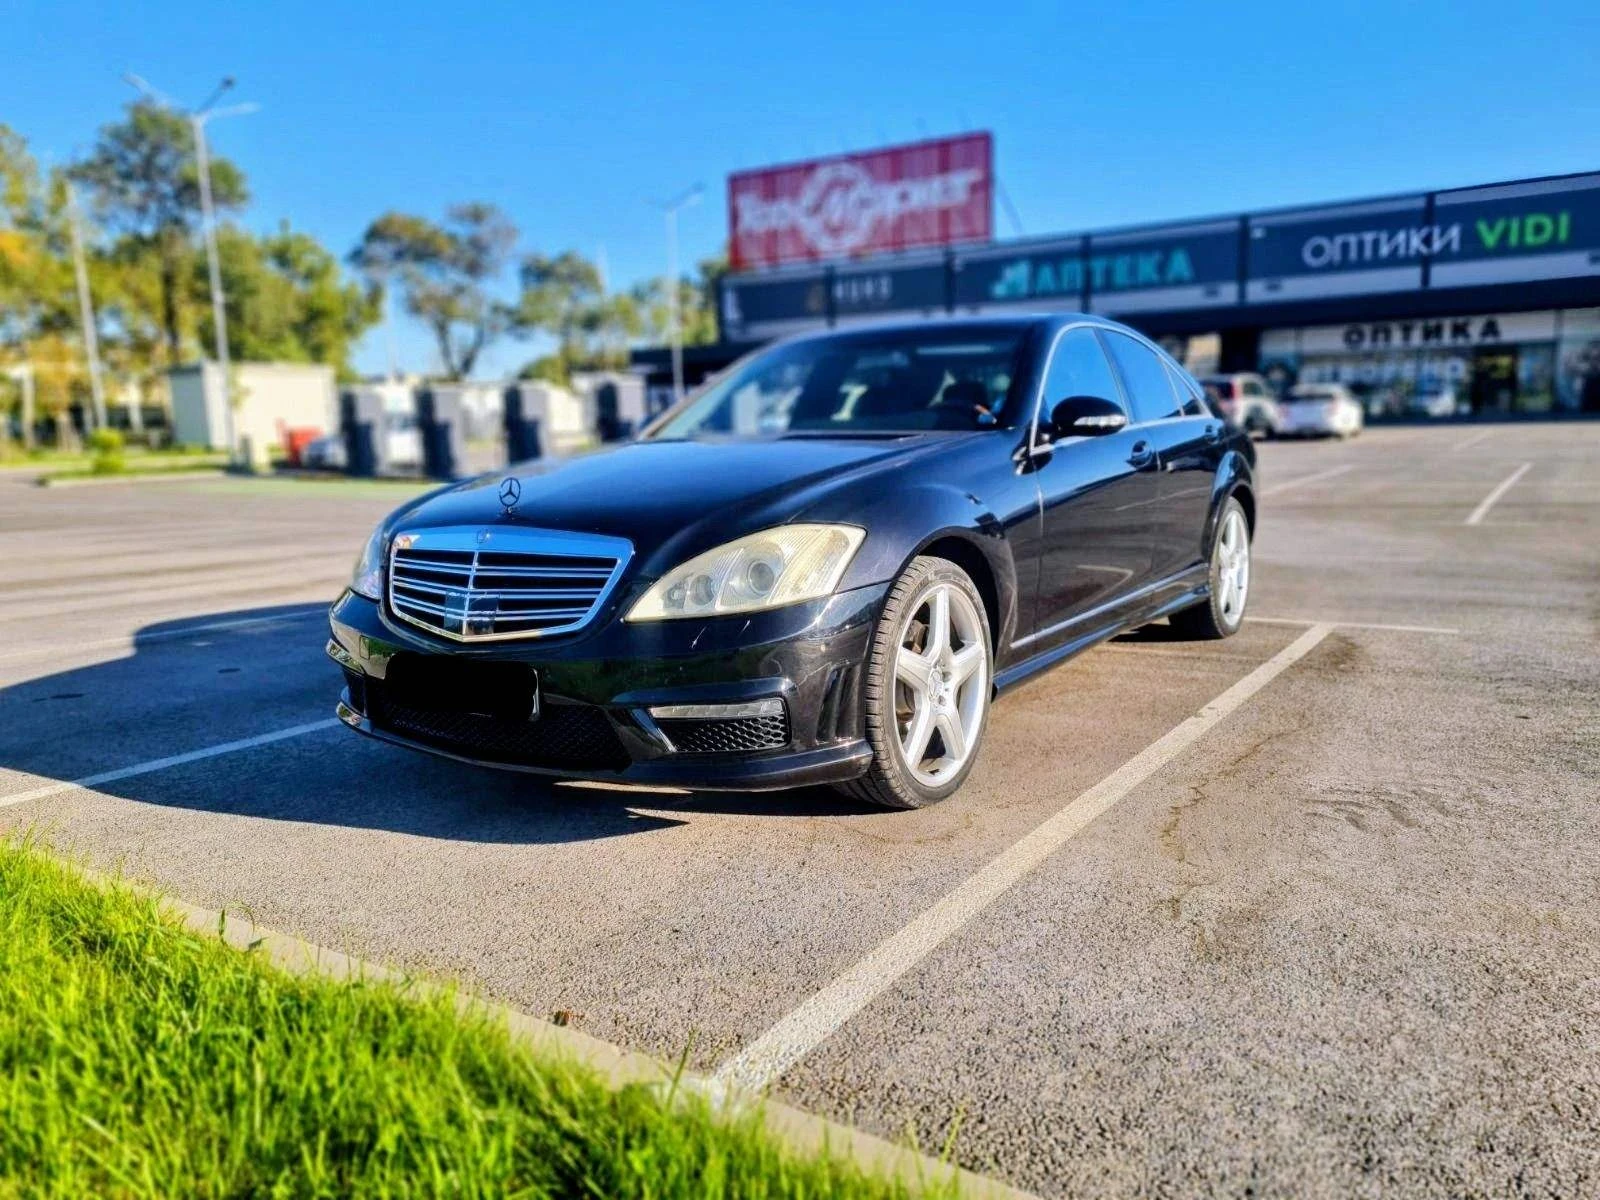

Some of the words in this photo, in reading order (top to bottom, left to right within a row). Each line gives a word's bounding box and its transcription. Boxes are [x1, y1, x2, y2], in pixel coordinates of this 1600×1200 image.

[1302, 224, 1462, 268] ОПТИКИ
[1476, 211, 1571, 248] VIDI
[1035, 248, 1194, 290] АПТЕКА
[1343, 317, 1500, 347] ОПТИКА
